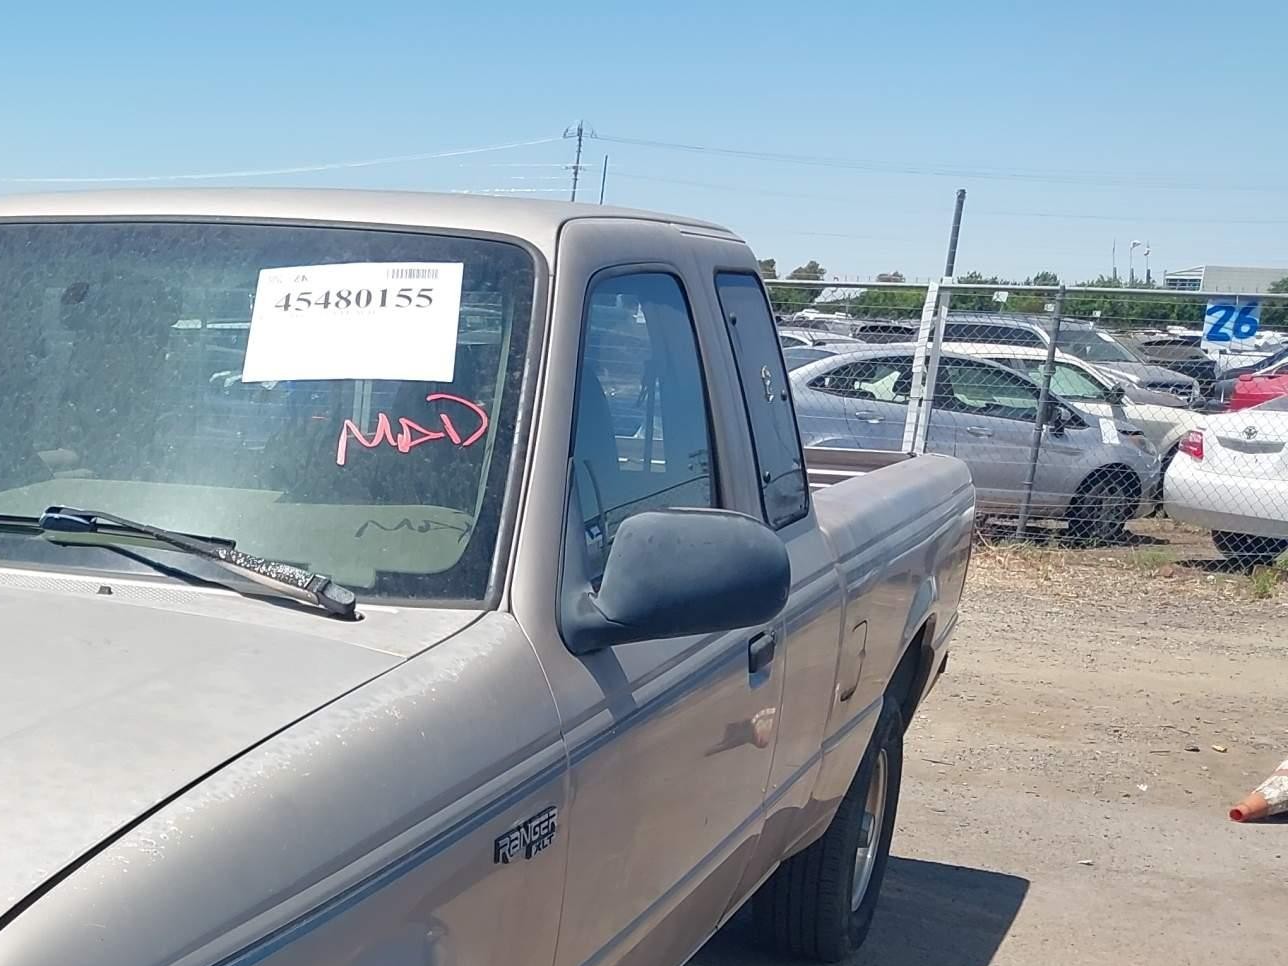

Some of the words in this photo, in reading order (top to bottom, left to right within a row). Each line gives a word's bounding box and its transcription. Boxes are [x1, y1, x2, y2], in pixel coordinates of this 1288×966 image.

[274, 287, 434, 312] 45480155
[1206, 302, 1258, 341] 26
[494, 806, 557, 864] RANGER
